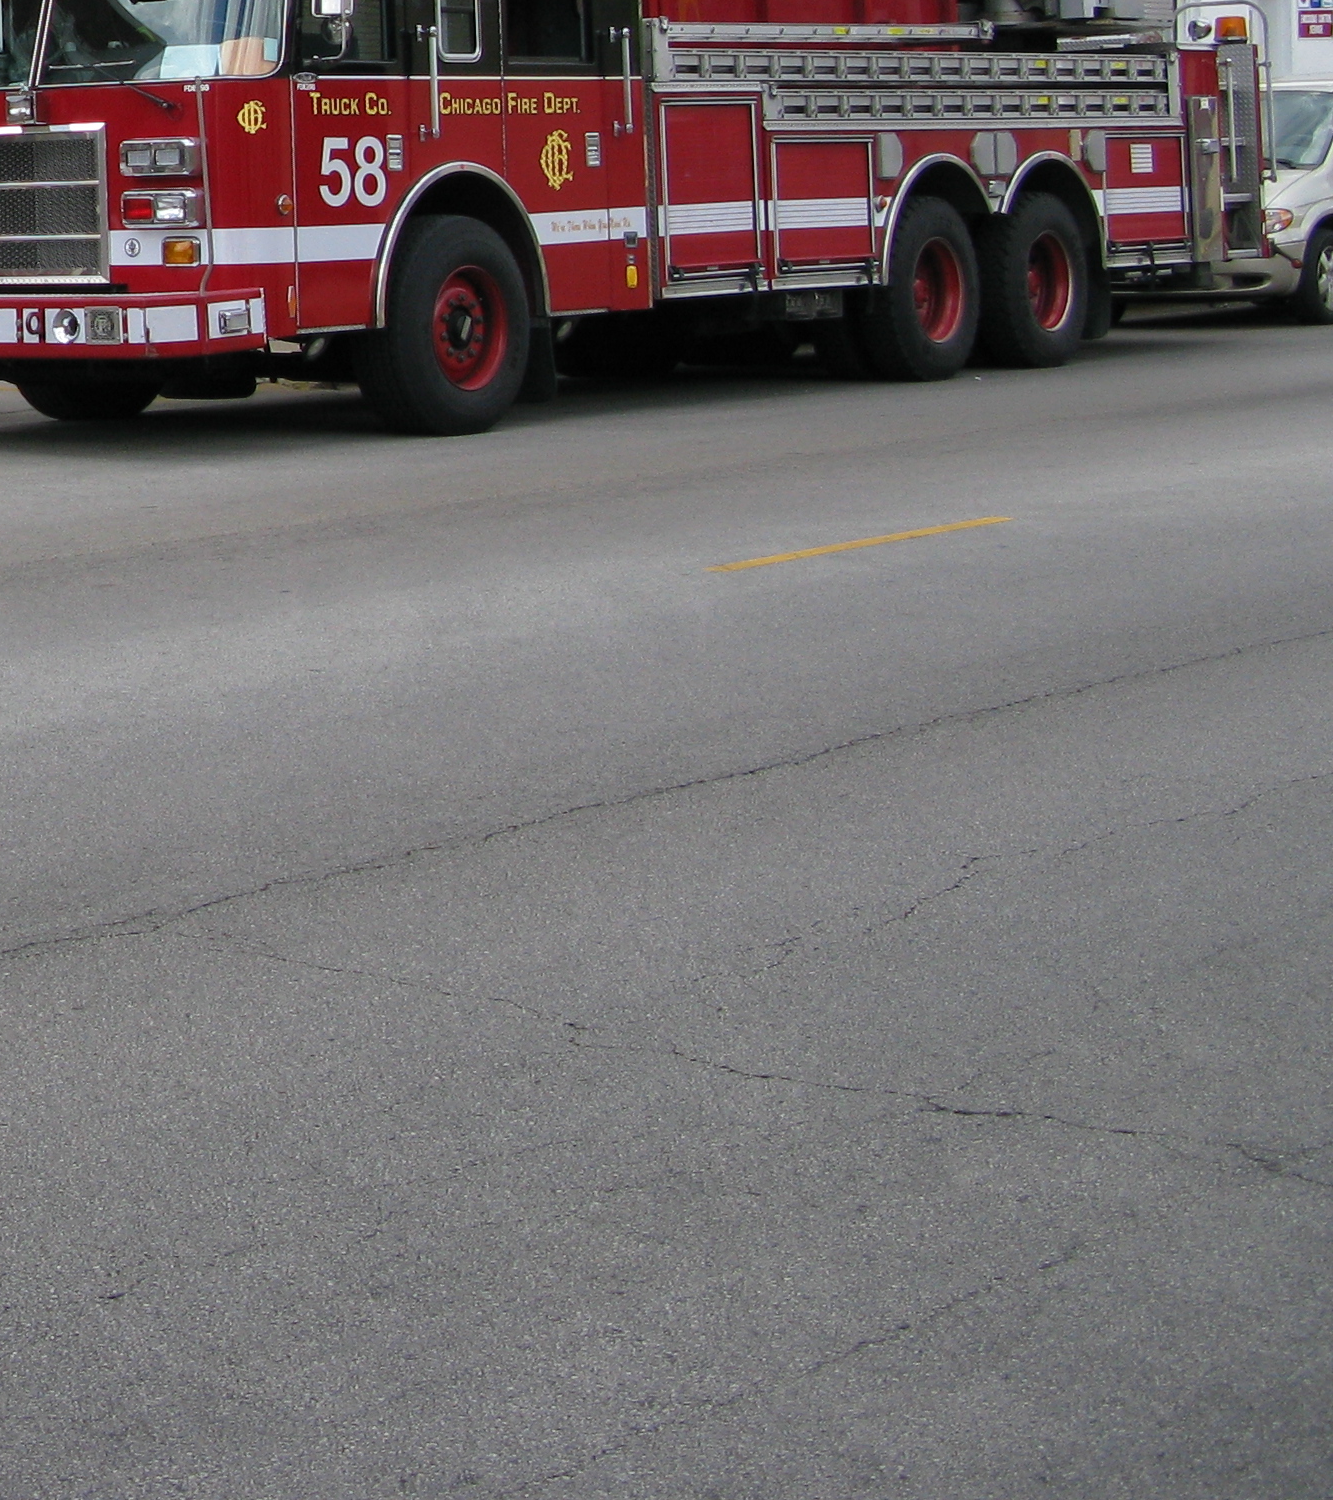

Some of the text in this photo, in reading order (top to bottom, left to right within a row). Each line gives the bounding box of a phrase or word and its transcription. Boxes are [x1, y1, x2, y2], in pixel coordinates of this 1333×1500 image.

[309, 92, 392, 115] TRUCK CO.
[439, 92, 581, 115] CHICAGO FIRE DEPT.
[319, 135, 387, 207] 58
